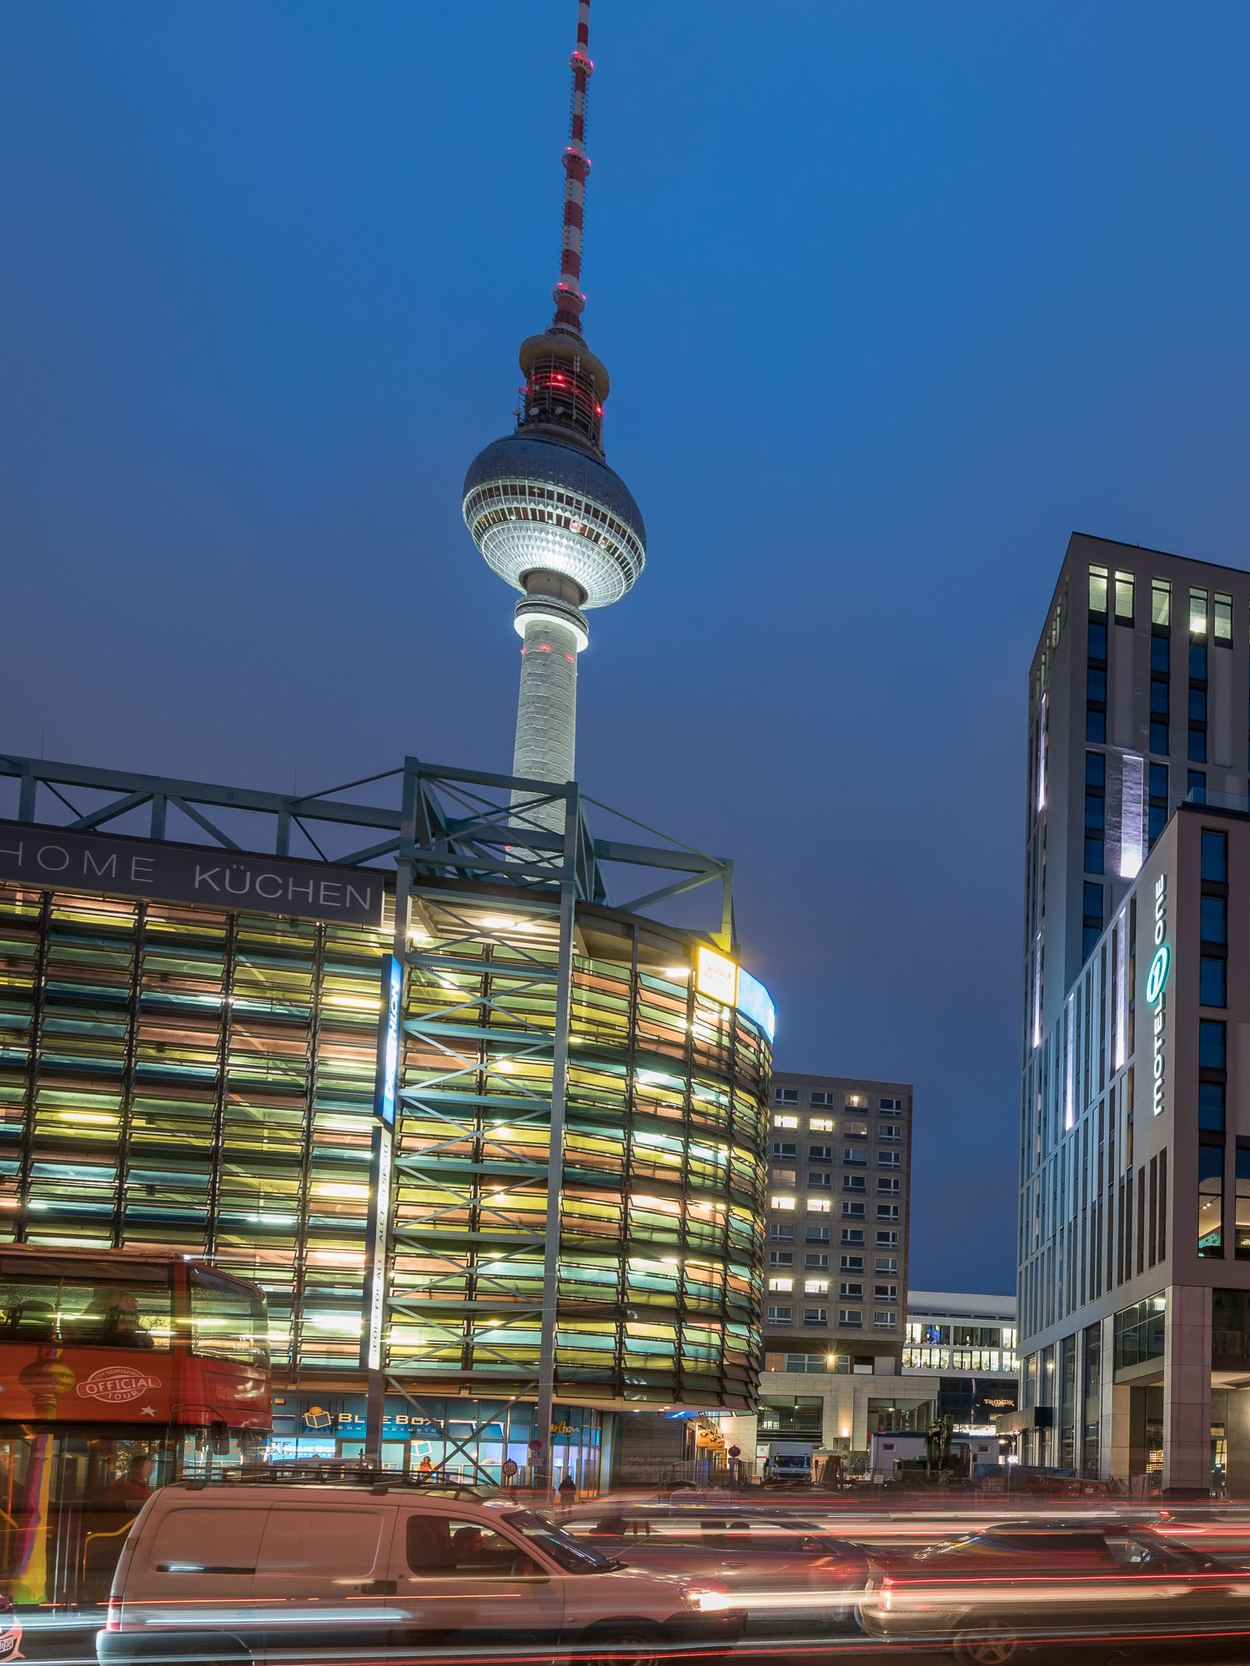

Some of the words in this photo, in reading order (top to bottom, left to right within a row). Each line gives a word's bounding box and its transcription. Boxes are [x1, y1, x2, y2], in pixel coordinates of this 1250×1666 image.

[0, 841, 156, 883] HOME
[194, 864, 371, 910] KÜCHEN
[384, 979, 400, 1099] DHLON
[85, 1378, 155, 1395] OFFICIAL
[107, 1389, 140, 1400] TOUR
